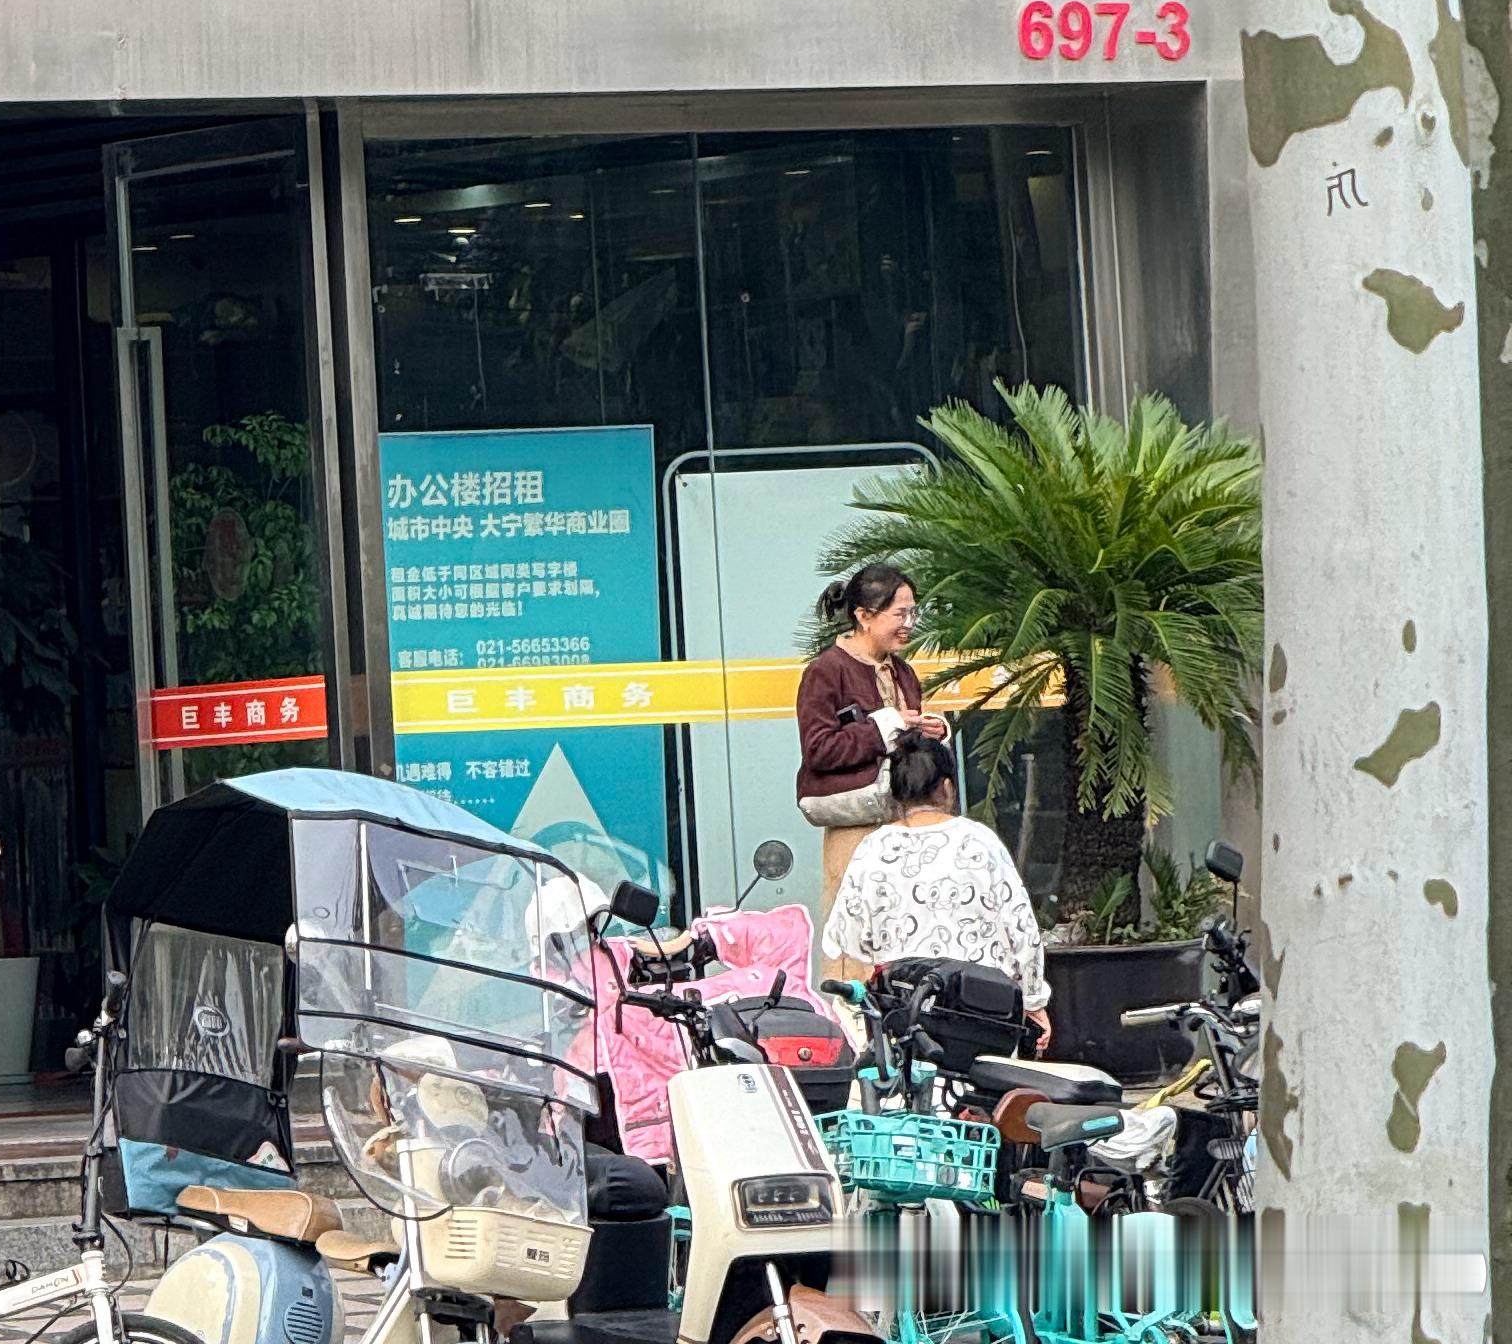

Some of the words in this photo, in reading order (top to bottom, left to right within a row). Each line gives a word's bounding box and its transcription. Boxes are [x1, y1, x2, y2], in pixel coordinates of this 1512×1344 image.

[1018, 0, 1191, 61] 697-3
[387, 470, 545, 509] 办公楼招租
[386, 514, 474, 541] 城市中央
[479, 509, 631, 539] 大宁繁华商业圈
[476, 636, 591, 655] 021-56653366
[180, 696, 300, 730] 巨丰商务
[446, 681, 654, 713] 巨丰商务
[465, 757, 531, 780] 不容错过
